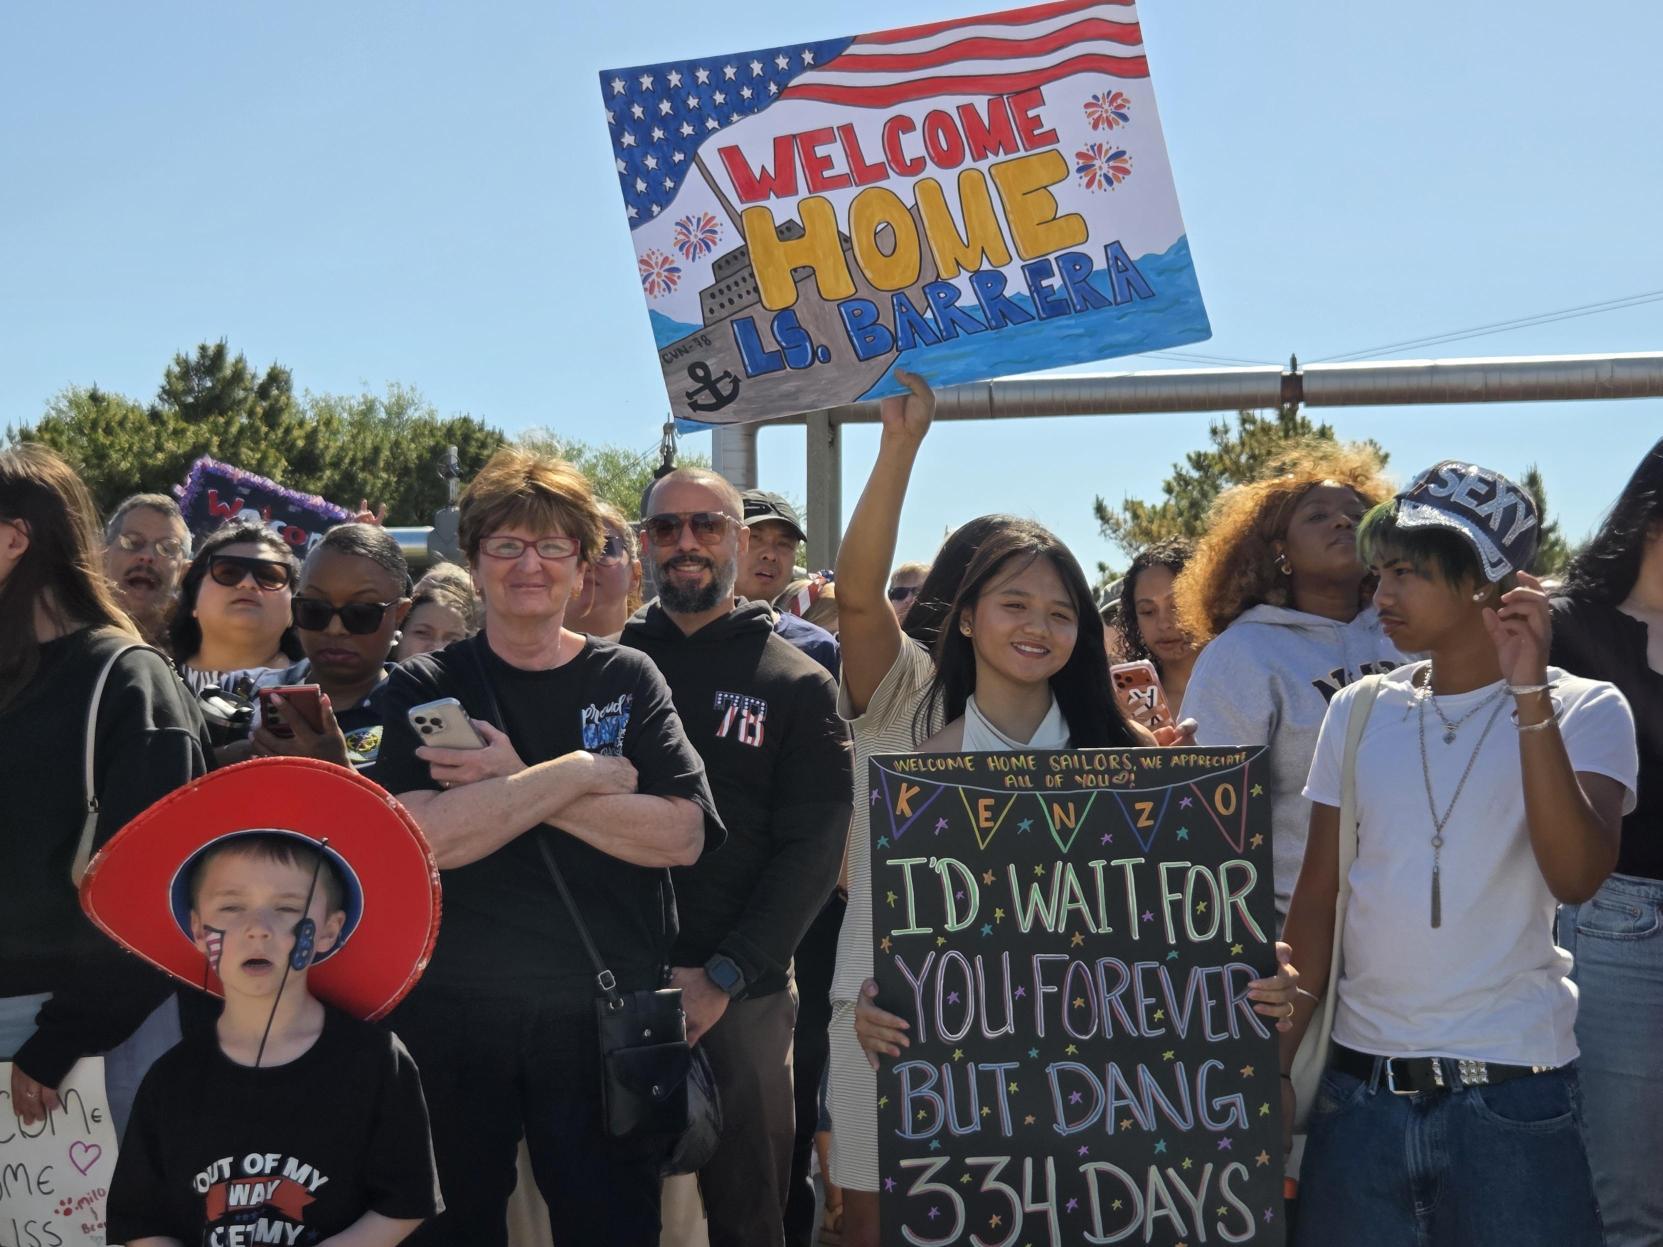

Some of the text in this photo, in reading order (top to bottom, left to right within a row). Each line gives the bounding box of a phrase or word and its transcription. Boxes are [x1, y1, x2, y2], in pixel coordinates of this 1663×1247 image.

[718, 87, 1059, 203] WELCOME
[738, 148, 1089, 312] HOME
[730, 239, 1155, 379] LS. BARRERA
[1427, 463, 1537, 548] SEXY
[714, 690, 767, 748] 78
[893, 751, 1247, 773] WELCOME HOME SAILORS, WE APPRECIATE
[1045, 774, 1064, 788] OF
[886, 856, 1268, 943] I'D WAIT FOR
[895, 950, 1271, 1043] YOU FOREVER
[892, 1059, 1250, 1139] BUT DANG
[193, 1152, 329, 1193] OUT OF MY
[228, 1179, 281, 1206] WAY
[899, 1155, 1256, 1247] 334 DAYS
[255, 1217, 304, 1246] MY
